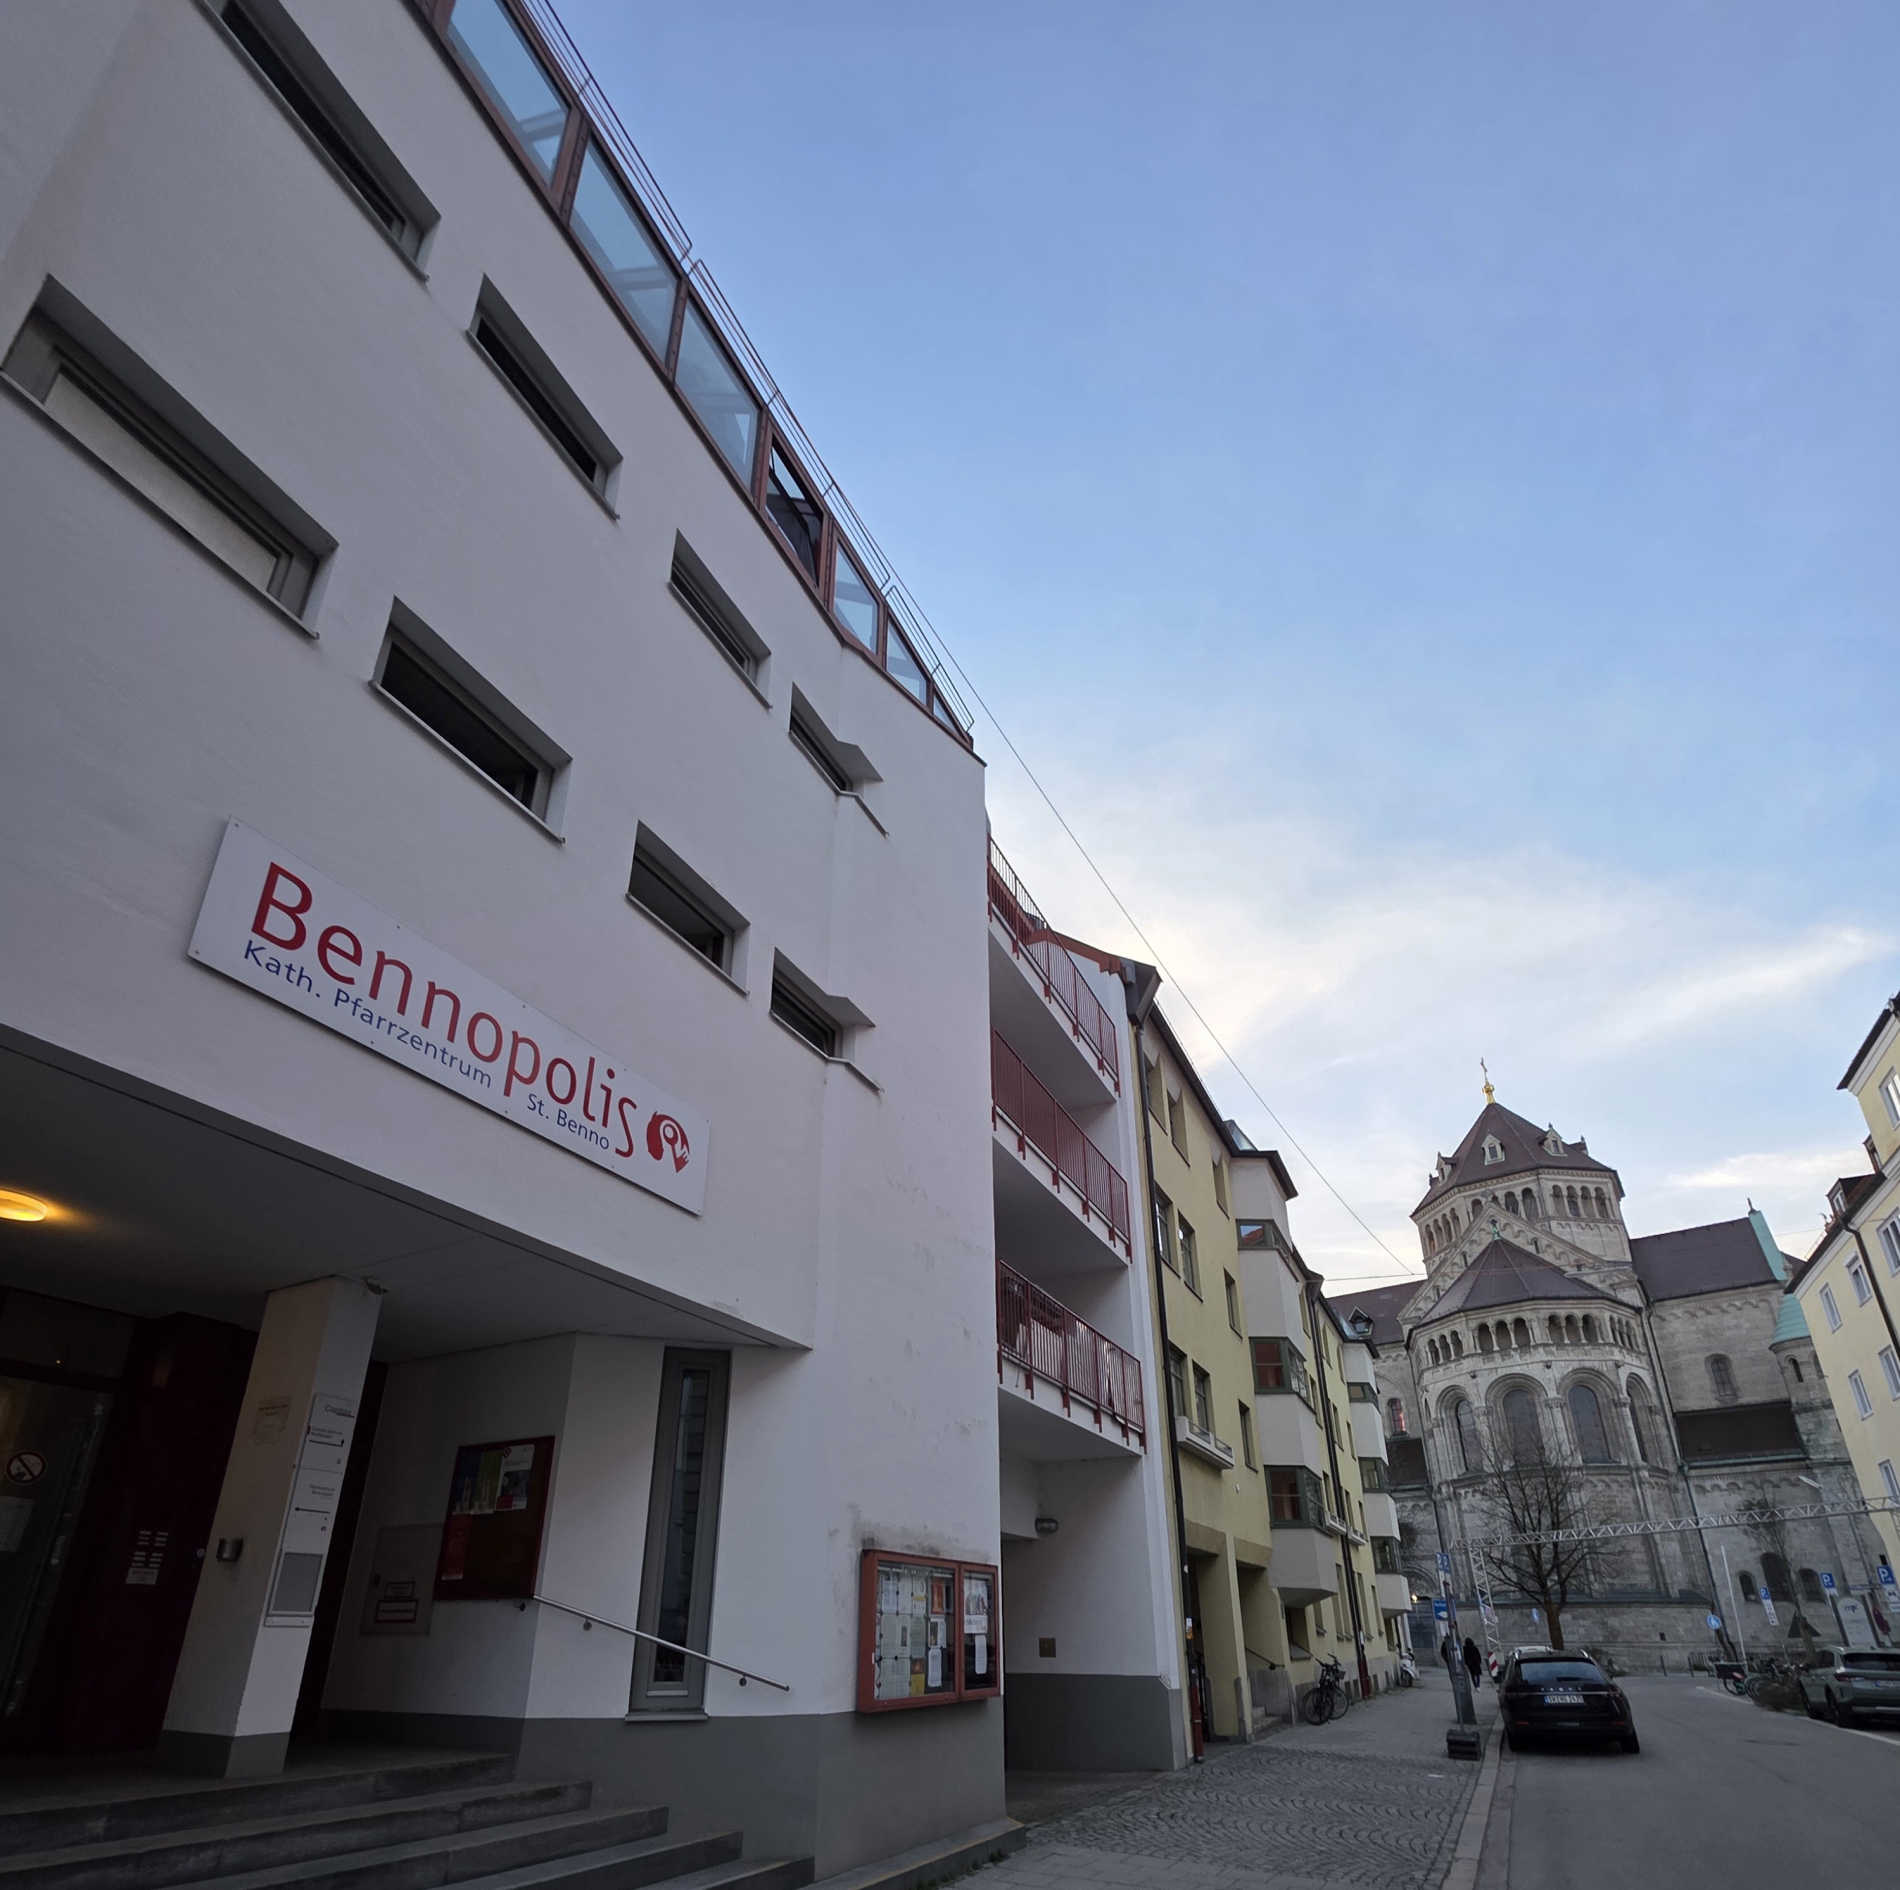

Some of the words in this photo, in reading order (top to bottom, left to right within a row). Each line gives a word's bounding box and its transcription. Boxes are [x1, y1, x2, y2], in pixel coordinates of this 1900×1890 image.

[244, 939, 320, 998] Kath.
[334, 988, 492, 1088] Pfarrzentrum
[527, 1093, 549, 1119] St.
[556, 1108, 610, 1150] Benno
[251, 862, 637, 1158] Bennopolis
[324, 1404, 352, 1415] Caritas
[1878, 1568, 1888, 1583] P
